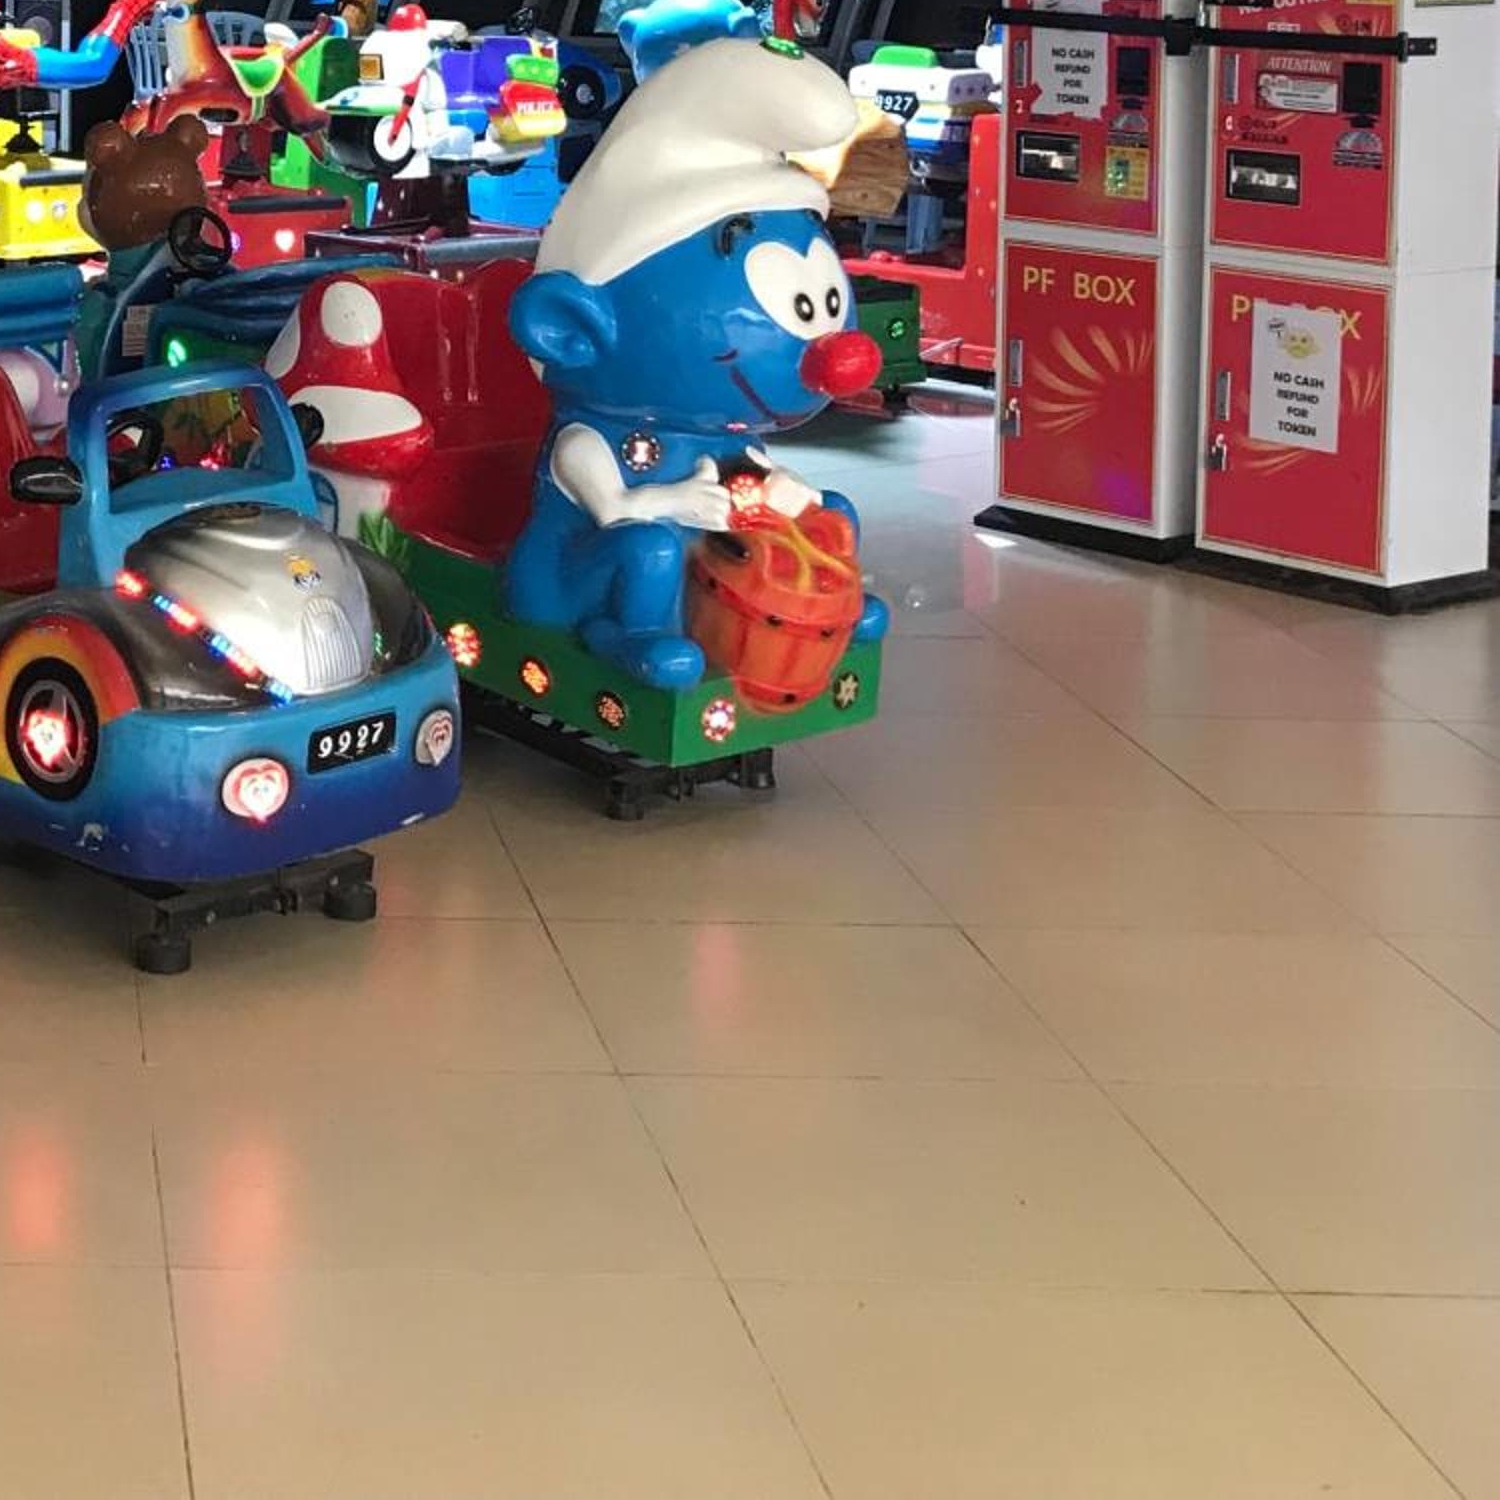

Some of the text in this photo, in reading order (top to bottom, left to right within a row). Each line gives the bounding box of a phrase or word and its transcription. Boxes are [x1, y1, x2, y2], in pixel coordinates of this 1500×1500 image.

[1051, 47, 1094, 59] NO CASH
[1054, 63, 1091, 74] REFUND
[1267, 57, 1332, 72] ATTENTION
[1063, 79, 1082, 88] FOR
[1056, 93, 1089, 104] TOKEN
[1023, 266, 1136, 306] PF BOX
[1273, 371, 1325, 388] NO CASH
[1276, 389, 1319, 404] REFUND
[1286, 406, 1309, 418] FOR
[1278, 420, 1317, 436] TOKEN
[318, 720, 384, 758] 9927
